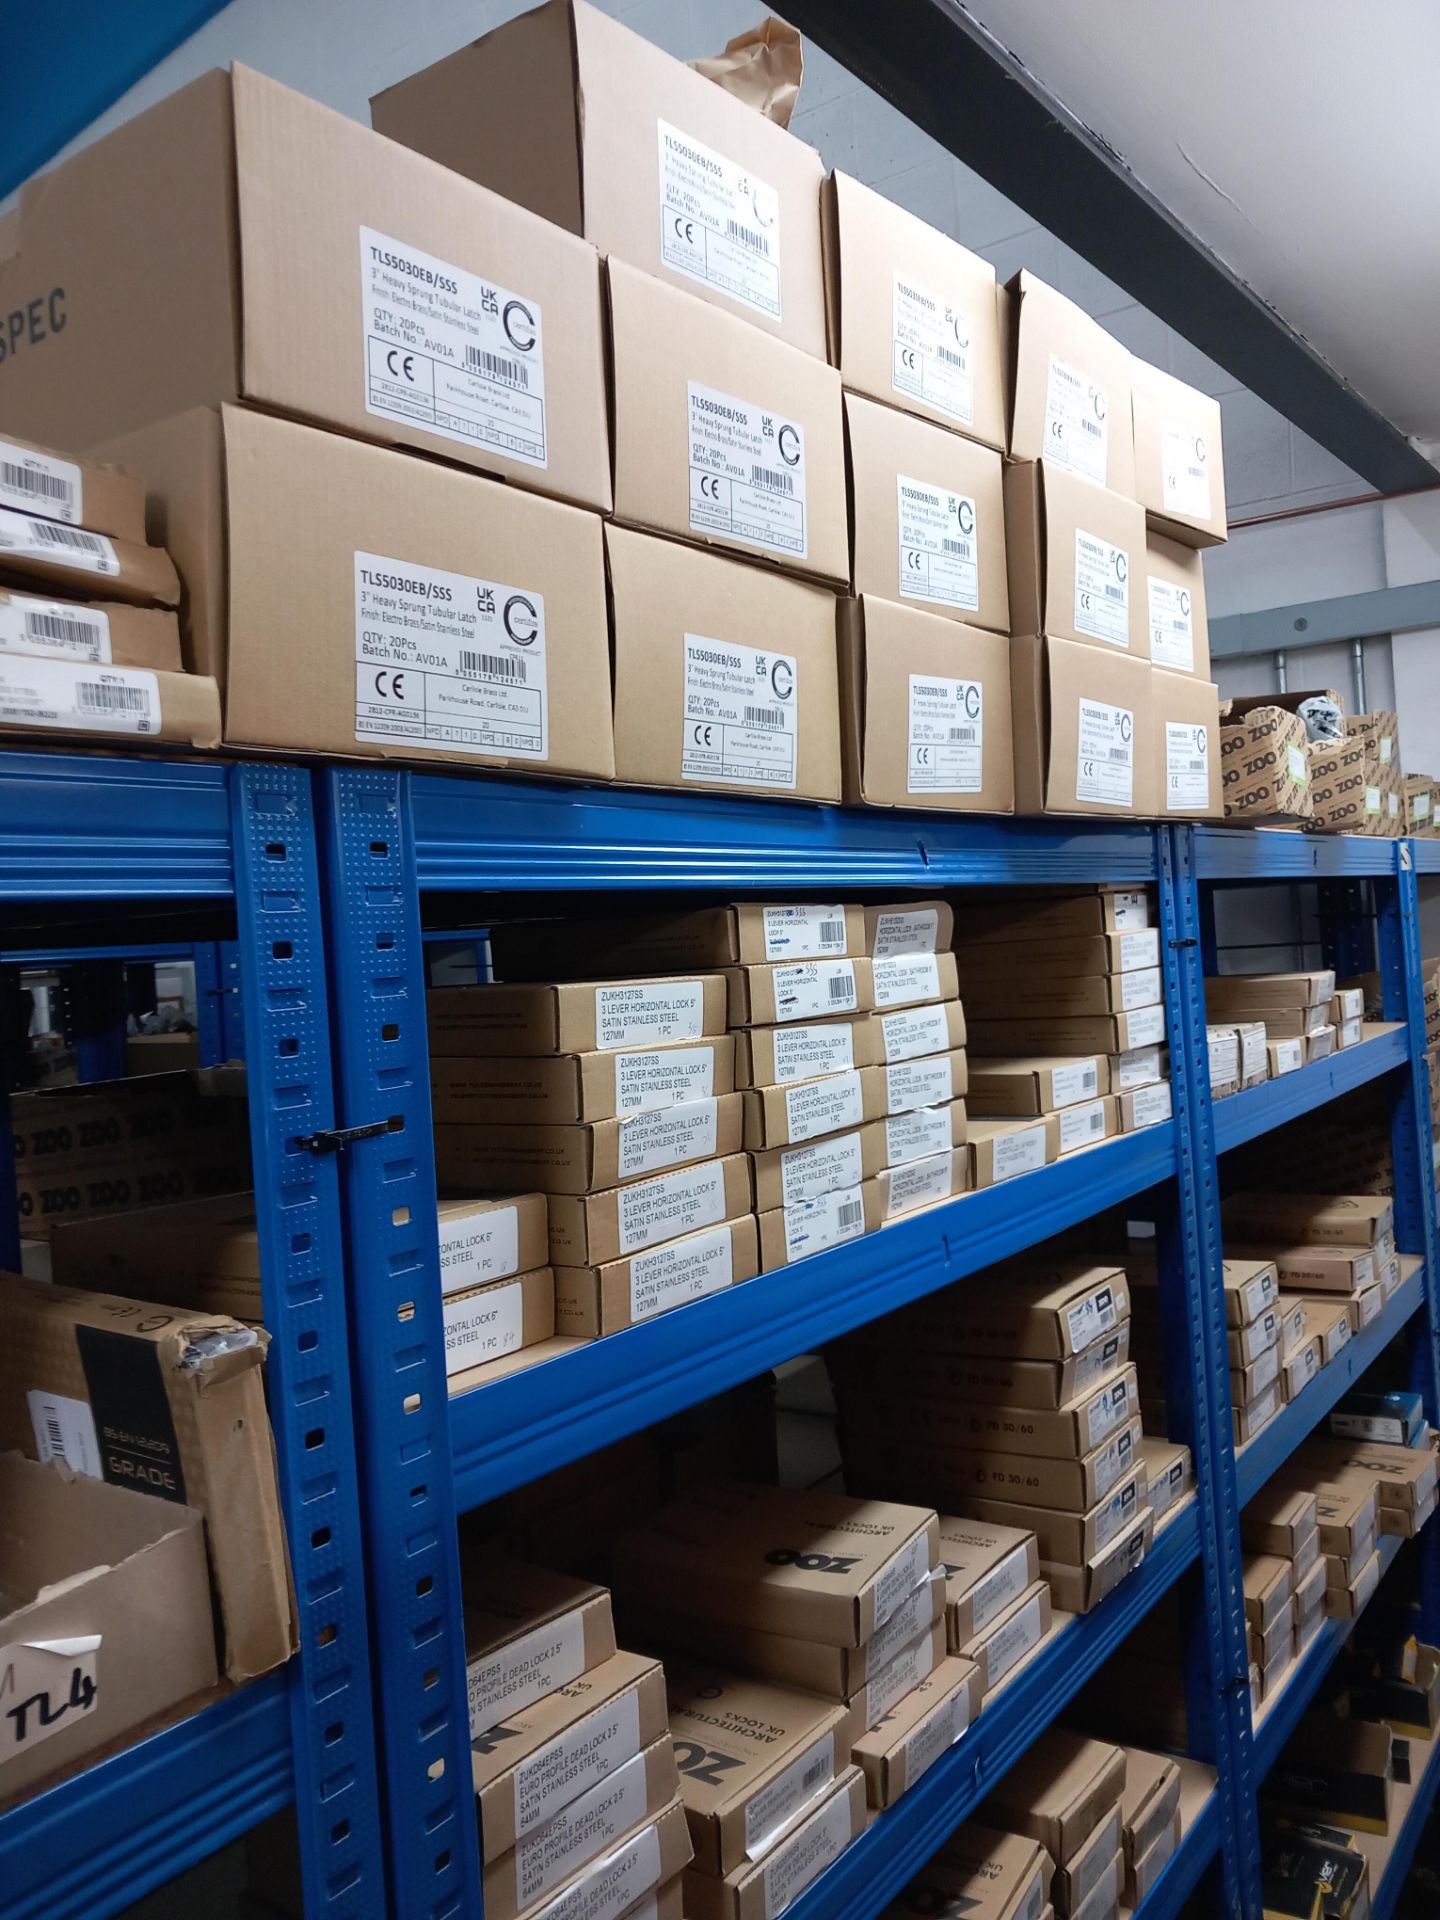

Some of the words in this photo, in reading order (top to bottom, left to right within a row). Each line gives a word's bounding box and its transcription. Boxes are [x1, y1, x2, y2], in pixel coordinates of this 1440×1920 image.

[370, 246, 457, 295] TLS5030EB/SSS
[480, 285, 497, 303] UK
[463, 306, 481, 321] Latch
[399, 317, 425, 335] 20Pcs
[374, 319, 400, 338] Batch
[424, 339, 454, 359] AV01A
[691, 395, 748, 426] TLS5030EB/SSS
[360, 569, 452, 602] TLS5030EB/SSS
[477, 585, 495, 601] UK
[372, 593, 397, 610] Heavy
[399, 599, 426, 617] Sprung
[427, 604, 456, 620] Tubular
[458, 611, 477, 624] Latch
[477, 599, 496, 615] CA
[363, 631, 386, 645] QTY:
[389, 635, 417, 650] 20Pcs
[362, 644, 390, 658] Batch
[416, 653, 448, 667] AV01A
[687, 647, 742, 669] TLS5030EB/SSS
[1248, 719, 1277, 742] ZOO
[1243, 752, 1276, 776] ZOO
[1311, 761, 1337, 780] ZOO
[1336, 775, 1363, 793] ZOO
[1235, 787, 1269, 810] ZOO
[1328, 803, 1357, 821] ZOO
[601, 990, 643, 1001] ZUKH3127SS
[602, 1005, 606, 1014] 3
[608, 1003, 629, 1014] LEVER
[631, 1001, 671, 1012] HORIZONTAL
[672, 999, 689, 1009] LOCK
[602, 1017, 621, 1028] SATIN
[623, 1015, 658, 1026] STAINLESS
[660, 1012, 679, 1023] STEEL
[603, 1030, 624, 1040] 127MM
[663, 1026, 671, 1035] PC
[620, 1056, 659, 1067] ZUKH3127SS
[621, 1072, 625, 1081] 3
[626, 1070, 646, 1080] LEVER
[647, 1066, 684, 1078] HORIZONTAL
[685, 1065, 701, 1074] LOCK
[621, 1084, 639, 1094] SATIN
[641, 1080, 672, 1092] STAINLESS
[674, 1078, 691, 1088] STEEL
[622, 1096, 641, 1107] 127MM
[677, 1091, 684, 1099] PC
[624, 1133, 627, 1142] 3
[629, 1129, 648, 1141] LEVER
[650, 1121, 687, 1136] HORIZONTAL
[688, 1117, 704, 1127] LOCK
[624, 1145, 641, 1156] SATIN
[643, 1137, 675, 1151] STAINLESS
[676, 1131, 694, 1143] STEEL
[624, 1156, 643, 1168] 127MM
[679, 1145, 687, 1155] PC
[623, 1184, 664, 1204] ZUKH3127SS
[624, 1208, 628, 1217] 3
[629, 1201, 651, 1216] LEVER
[653, 1190, 693, 1208] HORIZONTAL
[693, 1183, 710, 1196] LOCK
[624, 1219, 644, 1231] SATIN
[646, 1206, 680, 1224] STAINLESS
[682, 1200, 701, 1212] STEEL
[626, 1229, 647, 1244] 127MM
[685, 1214, 694, 1224] PC
[466, 1234, 485, 1247] LOCK
[452, 1251, 474, 1265] STEEL
[482, 1259, 492, 1269] PC
[635, 1250, 675, 1272] ZUKH3127SS
[636, 1276, 639, 1286] 3
[641, 1269, 662, 1284] LEVER
[663, 1256, 701, 1274] HORIZONTAL
[702, 1249, 718, 1262] LOCK
[636, 1287, 655, 1299] SATIN
[656, 1272, 690, 1292] STAINLESS
[691, 1265, 709, 1279] STEEL
[637, 1296, 657, 1312] 127MM
[694, 1281, 702, 1290] PC
[472, 1313, 490, 1327] LOCK
[457, 1330, 479, 1346] STEEL
[487, 1338, 497, 1348] PC
[477, 1673, 507, 1697] PROFILE
[509, 1661, 529, 1679] DEAD
[530, 1650, 549, 1667] LOCK
[478, 1682, 517, 1712] STAINLESS
[519, 1668, 541, 1688] STEEL
[723, 1712, 764, 1729] LOCKS
[520, 1778, 540, 1799] EURO
[541, 1756, 569, 1785] PROFILE
[570, 1743, 588, 1764] DEAD
[589, 1732, 607, 1751] LOCK
[520, 1794, 540, 1813] SATIN
[542, 1765, 578, 1798] STAINLESS
[580, 1752, 599, 1772] STEEL
[522, 1848, 542, 1870] EURO
[544, 1825, 573, 1855] PROFILE
[574, 1811, 594, 1831] DEAD
[595, 1800, 613, 1818] LOCK
[522, 1864, 543, 1885] SATIN
[545, 1835, 583, 1869] STAINLESS
[584, 1818, 606, 1839] STEEL
[590, 1879, 608, 1900] DEAD
[609, 1866, 626, 1884] LOCK
